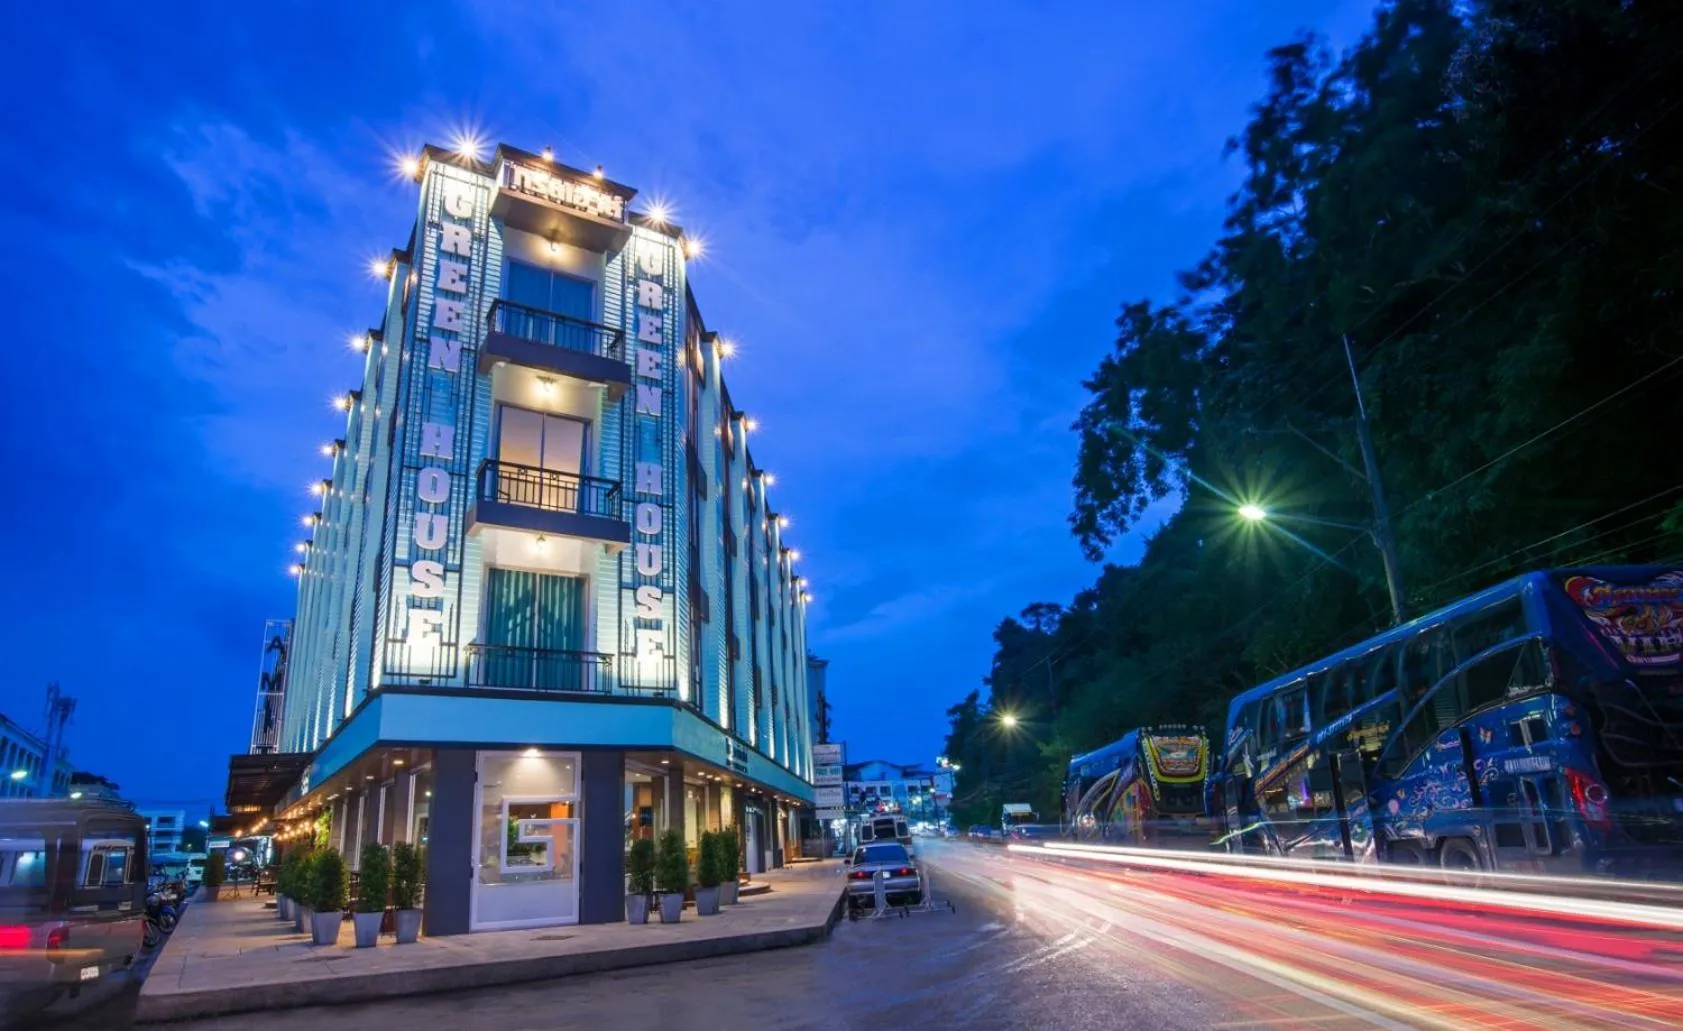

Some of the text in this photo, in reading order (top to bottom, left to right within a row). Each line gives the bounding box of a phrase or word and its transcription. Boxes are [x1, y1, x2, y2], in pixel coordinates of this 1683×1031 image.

[405, 182, 474, 650] GREEN HOUSE
[635, 243, 663, 664] GREEN HOUSE
